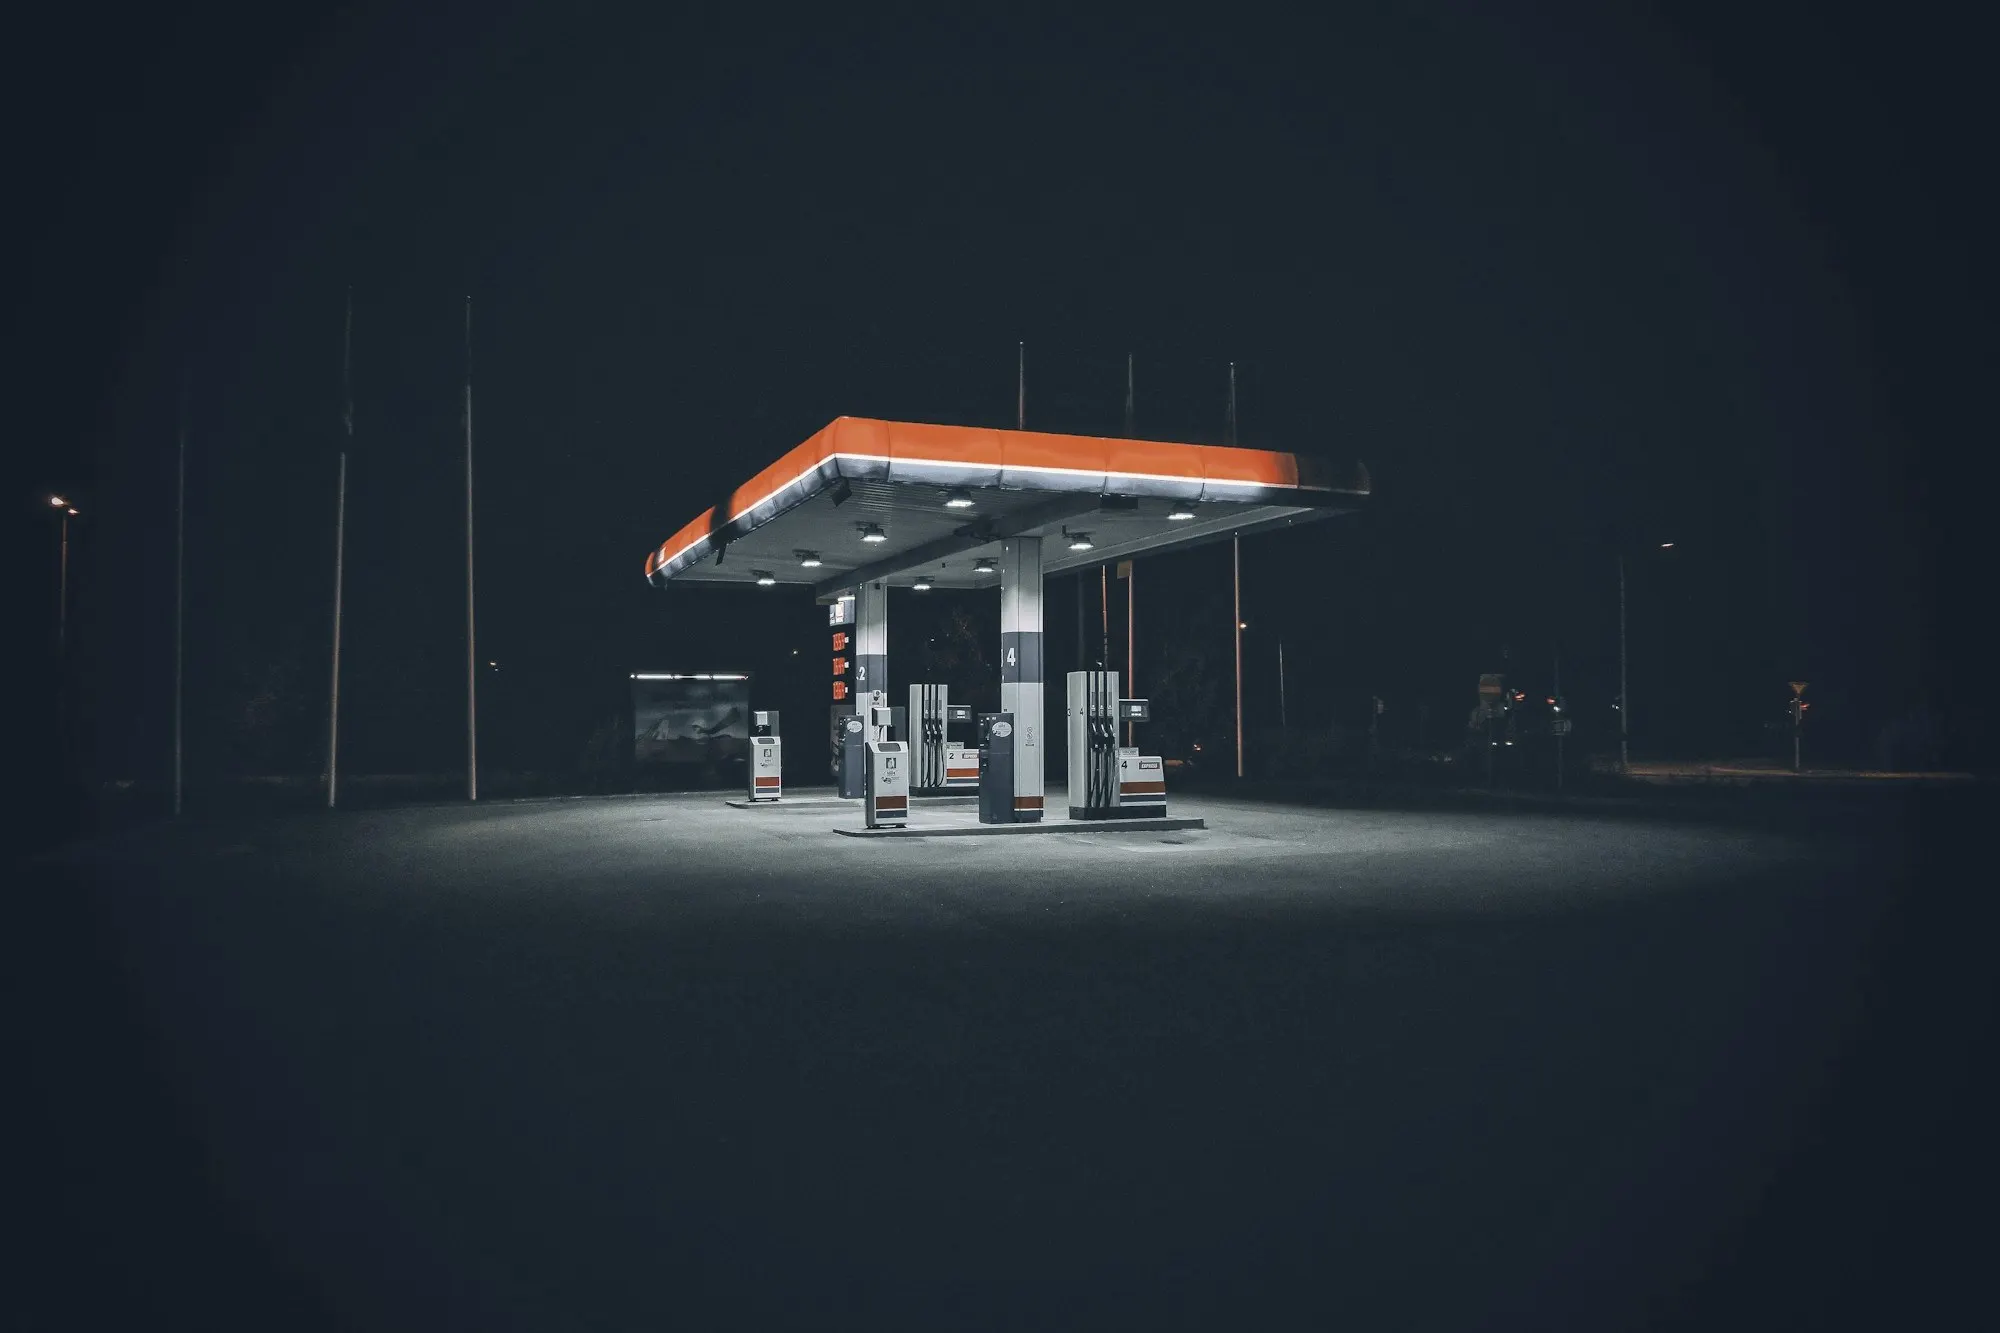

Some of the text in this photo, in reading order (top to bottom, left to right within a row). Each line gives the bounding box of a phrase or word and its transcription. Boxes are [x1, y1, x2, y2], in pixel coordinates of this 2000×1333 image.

[1006, 647, 1016, 667] 4
[859, 666, 866, 681] 2
[1121, 761, 1128, 769] 4
